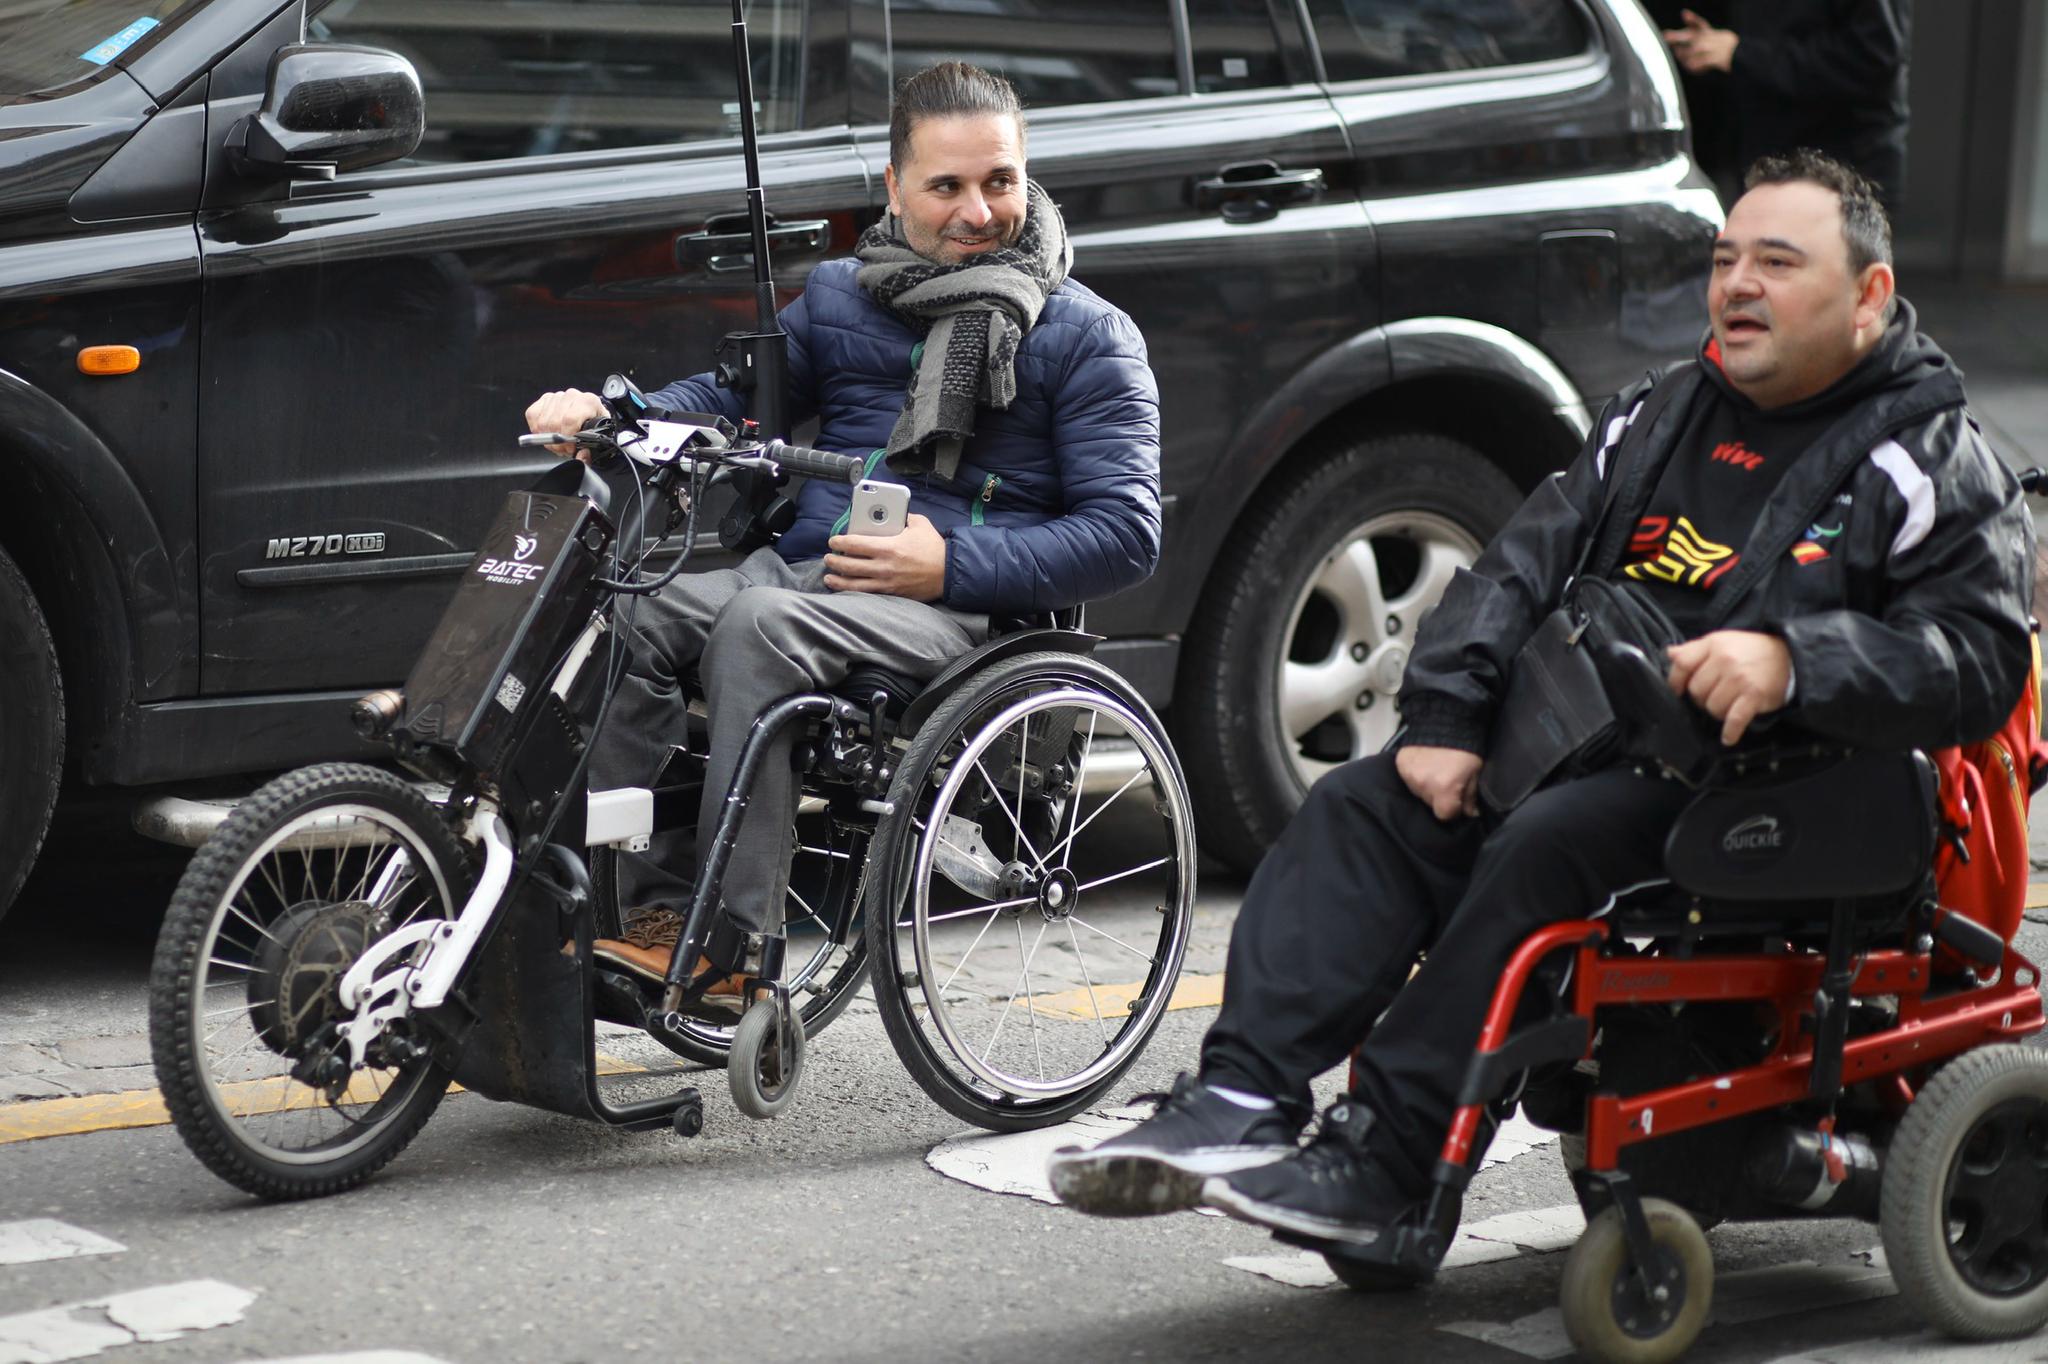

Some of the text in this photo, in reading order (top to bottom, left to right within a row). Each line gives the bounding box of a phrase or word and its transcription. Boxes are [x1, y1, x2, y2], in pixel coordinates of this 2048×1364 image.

[266, 534, 343, 559] M270
[477, 559, 544, 580] BATEC
[485, 575, 525, 586] MOBILITY
[1722, 831, 1782, 852] QUICKIE
